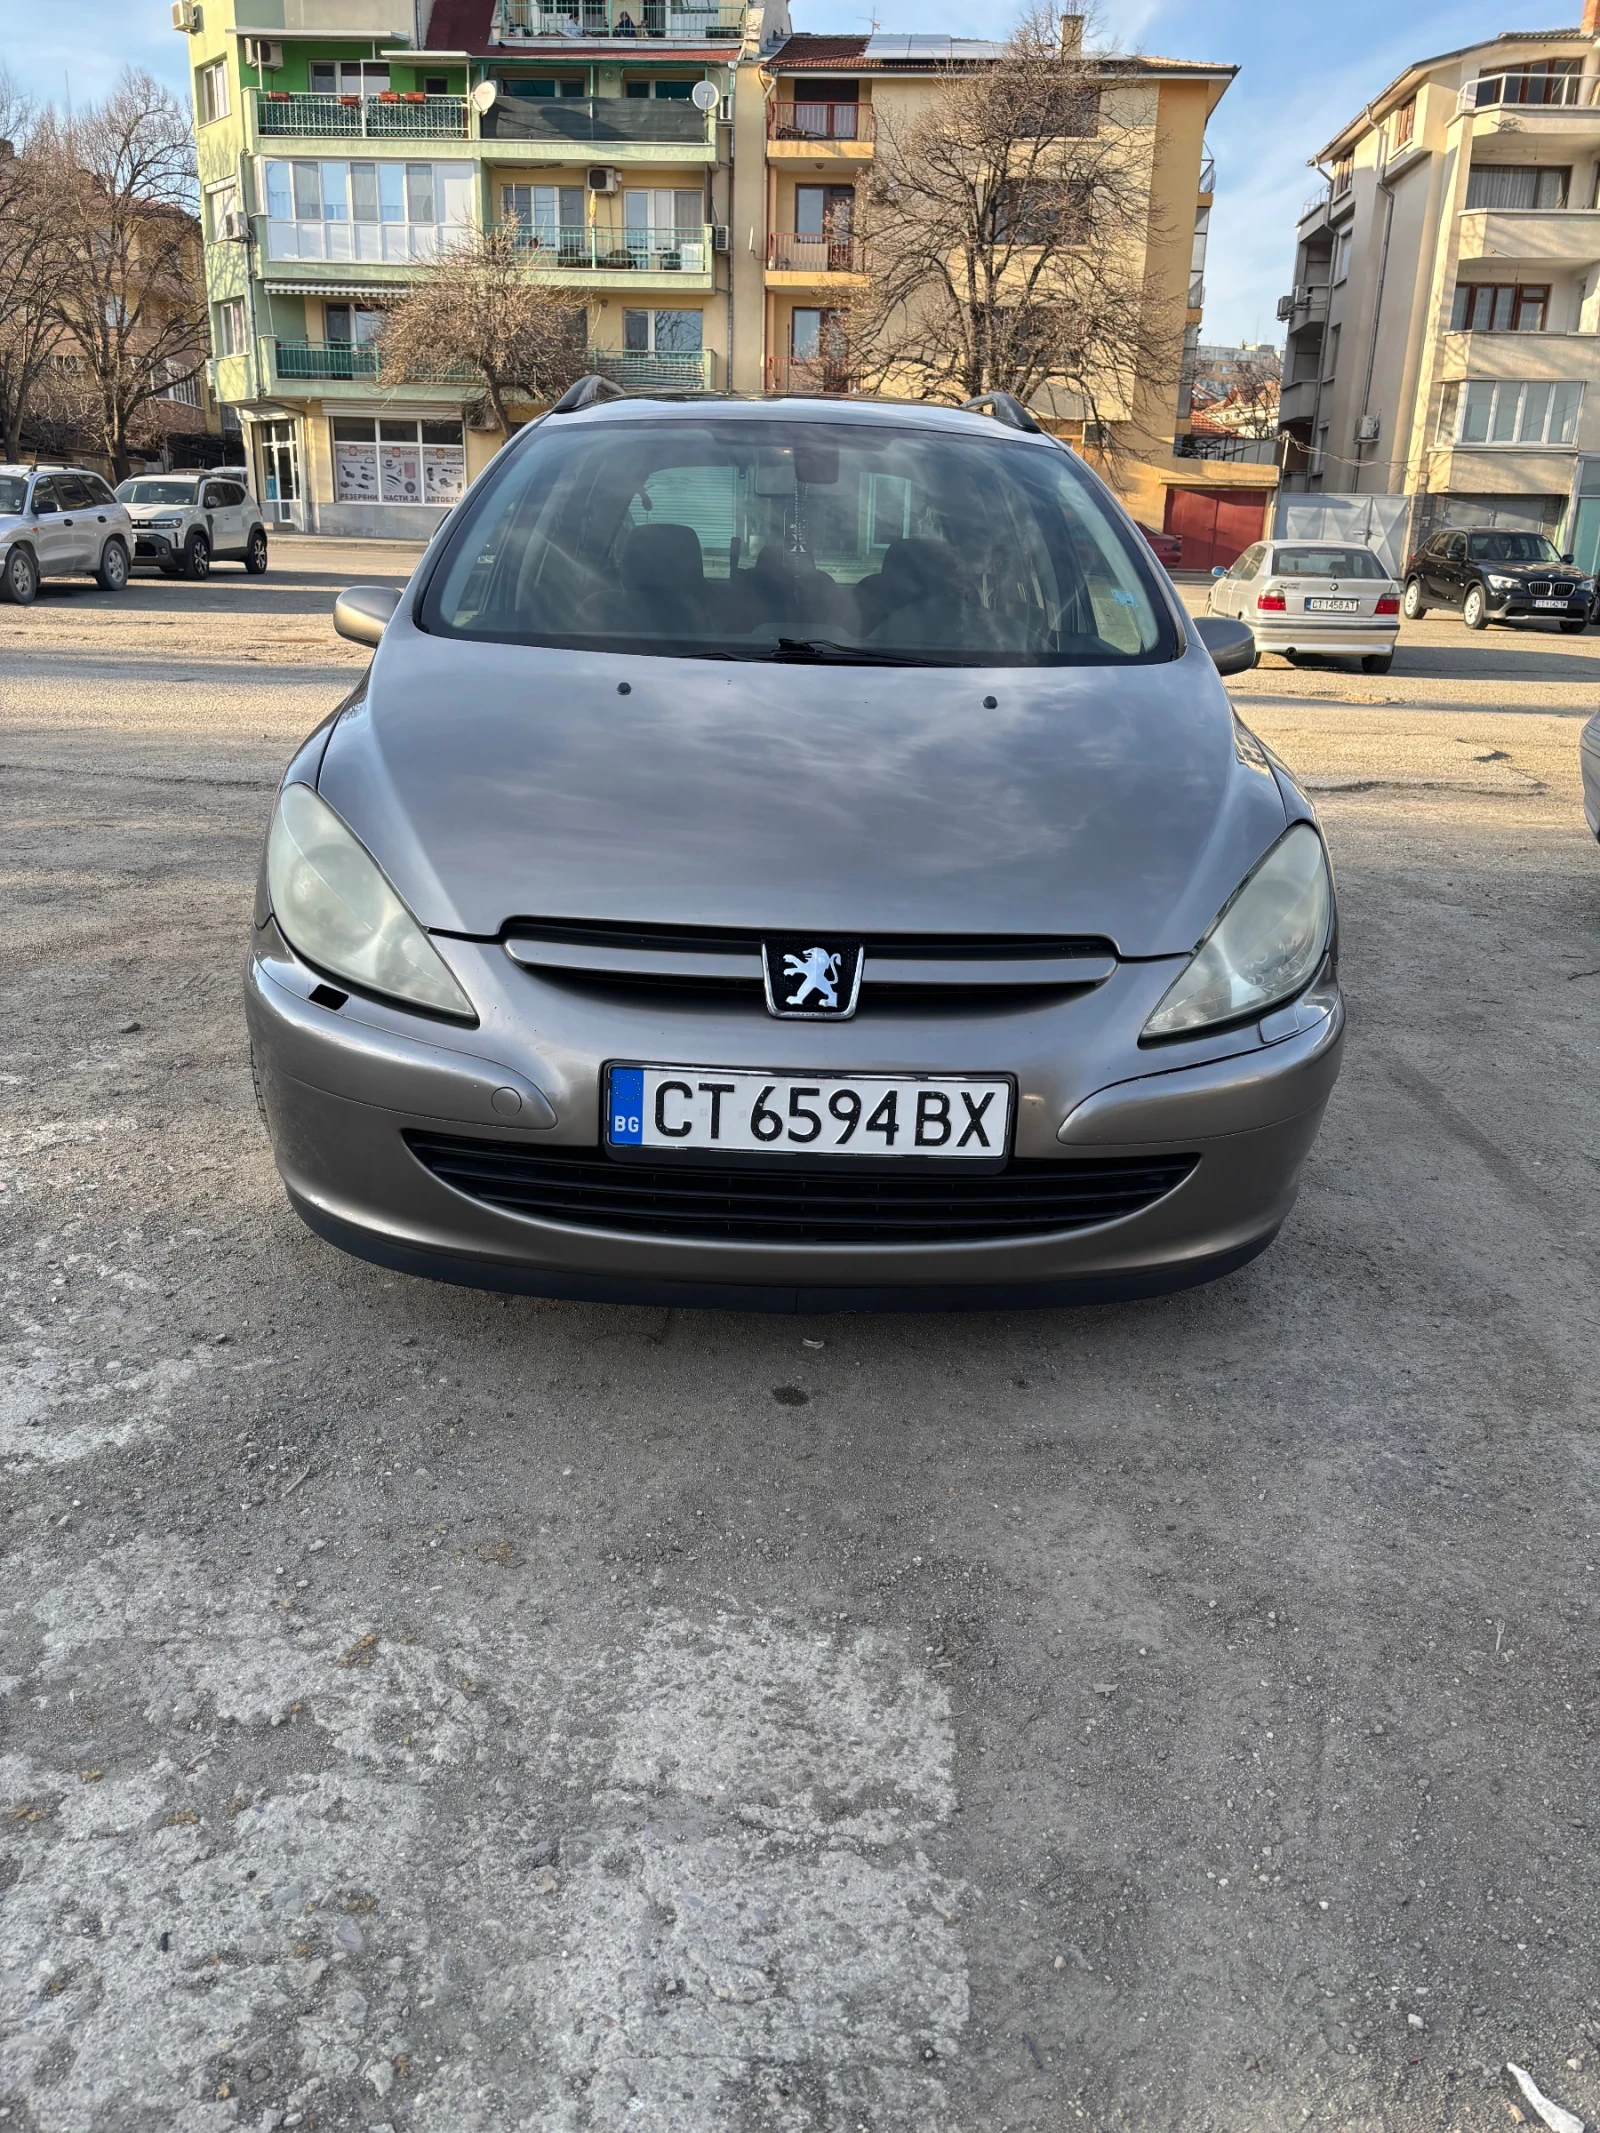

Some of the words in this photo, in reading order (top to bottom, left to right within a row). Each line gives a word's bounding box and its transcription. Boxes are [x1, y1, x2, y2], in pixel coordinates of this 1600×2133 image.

[383, 494, 408, 502] ЧАСТИ
[1325, 600, 1344, 610] 1458
[654, 1080, 735, 1140] CT
[750, 1085, 900, 1146] 6594
[914, 1091, 996, 1148] BX
[614, 1115, 640, 1134] BG
